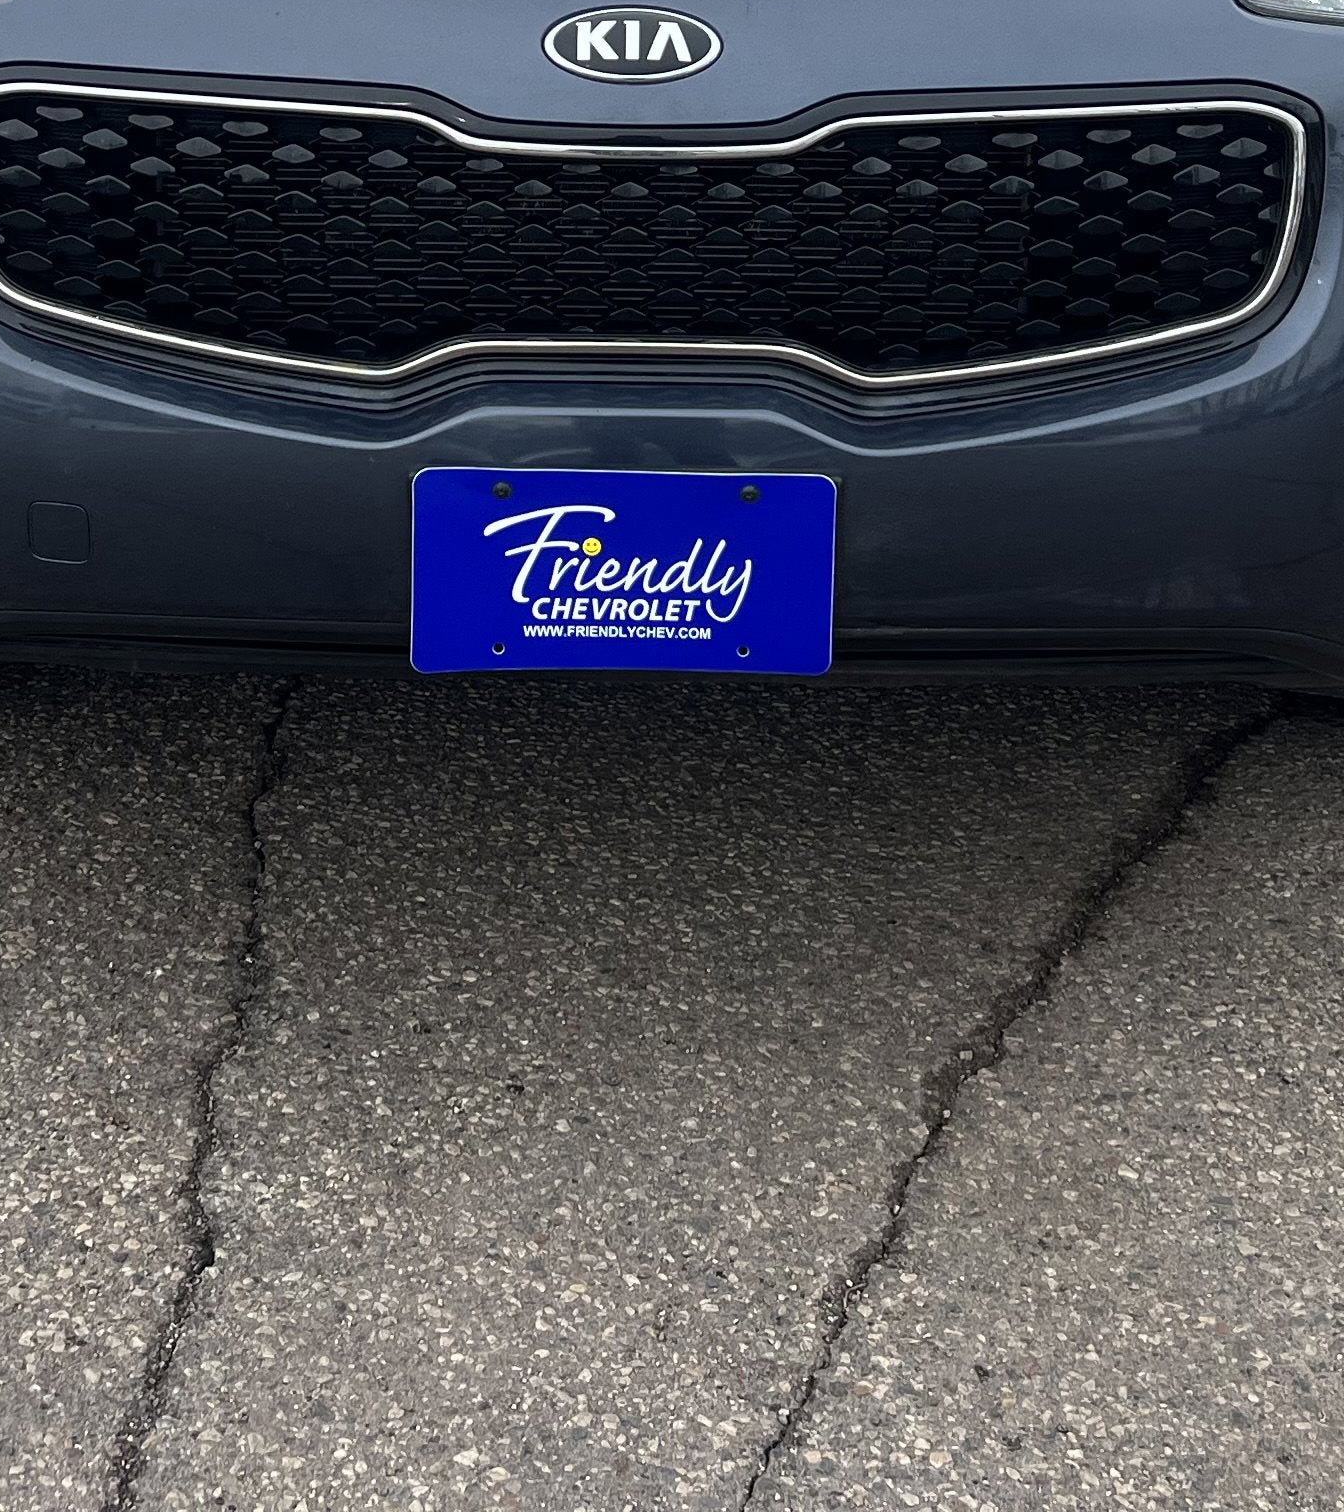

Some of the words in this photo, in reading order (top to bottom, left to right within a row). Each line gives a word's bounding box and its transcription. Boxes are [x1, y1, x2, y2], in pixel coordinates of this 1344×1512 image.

[575, 19, 692, 63] KIA
[483, 504, 752, 624] Friendly
[531, 597, 702, 622] CHEVROLET
[523, 624, 712, 640] WWW.FRIENDLYCHEV.COM
